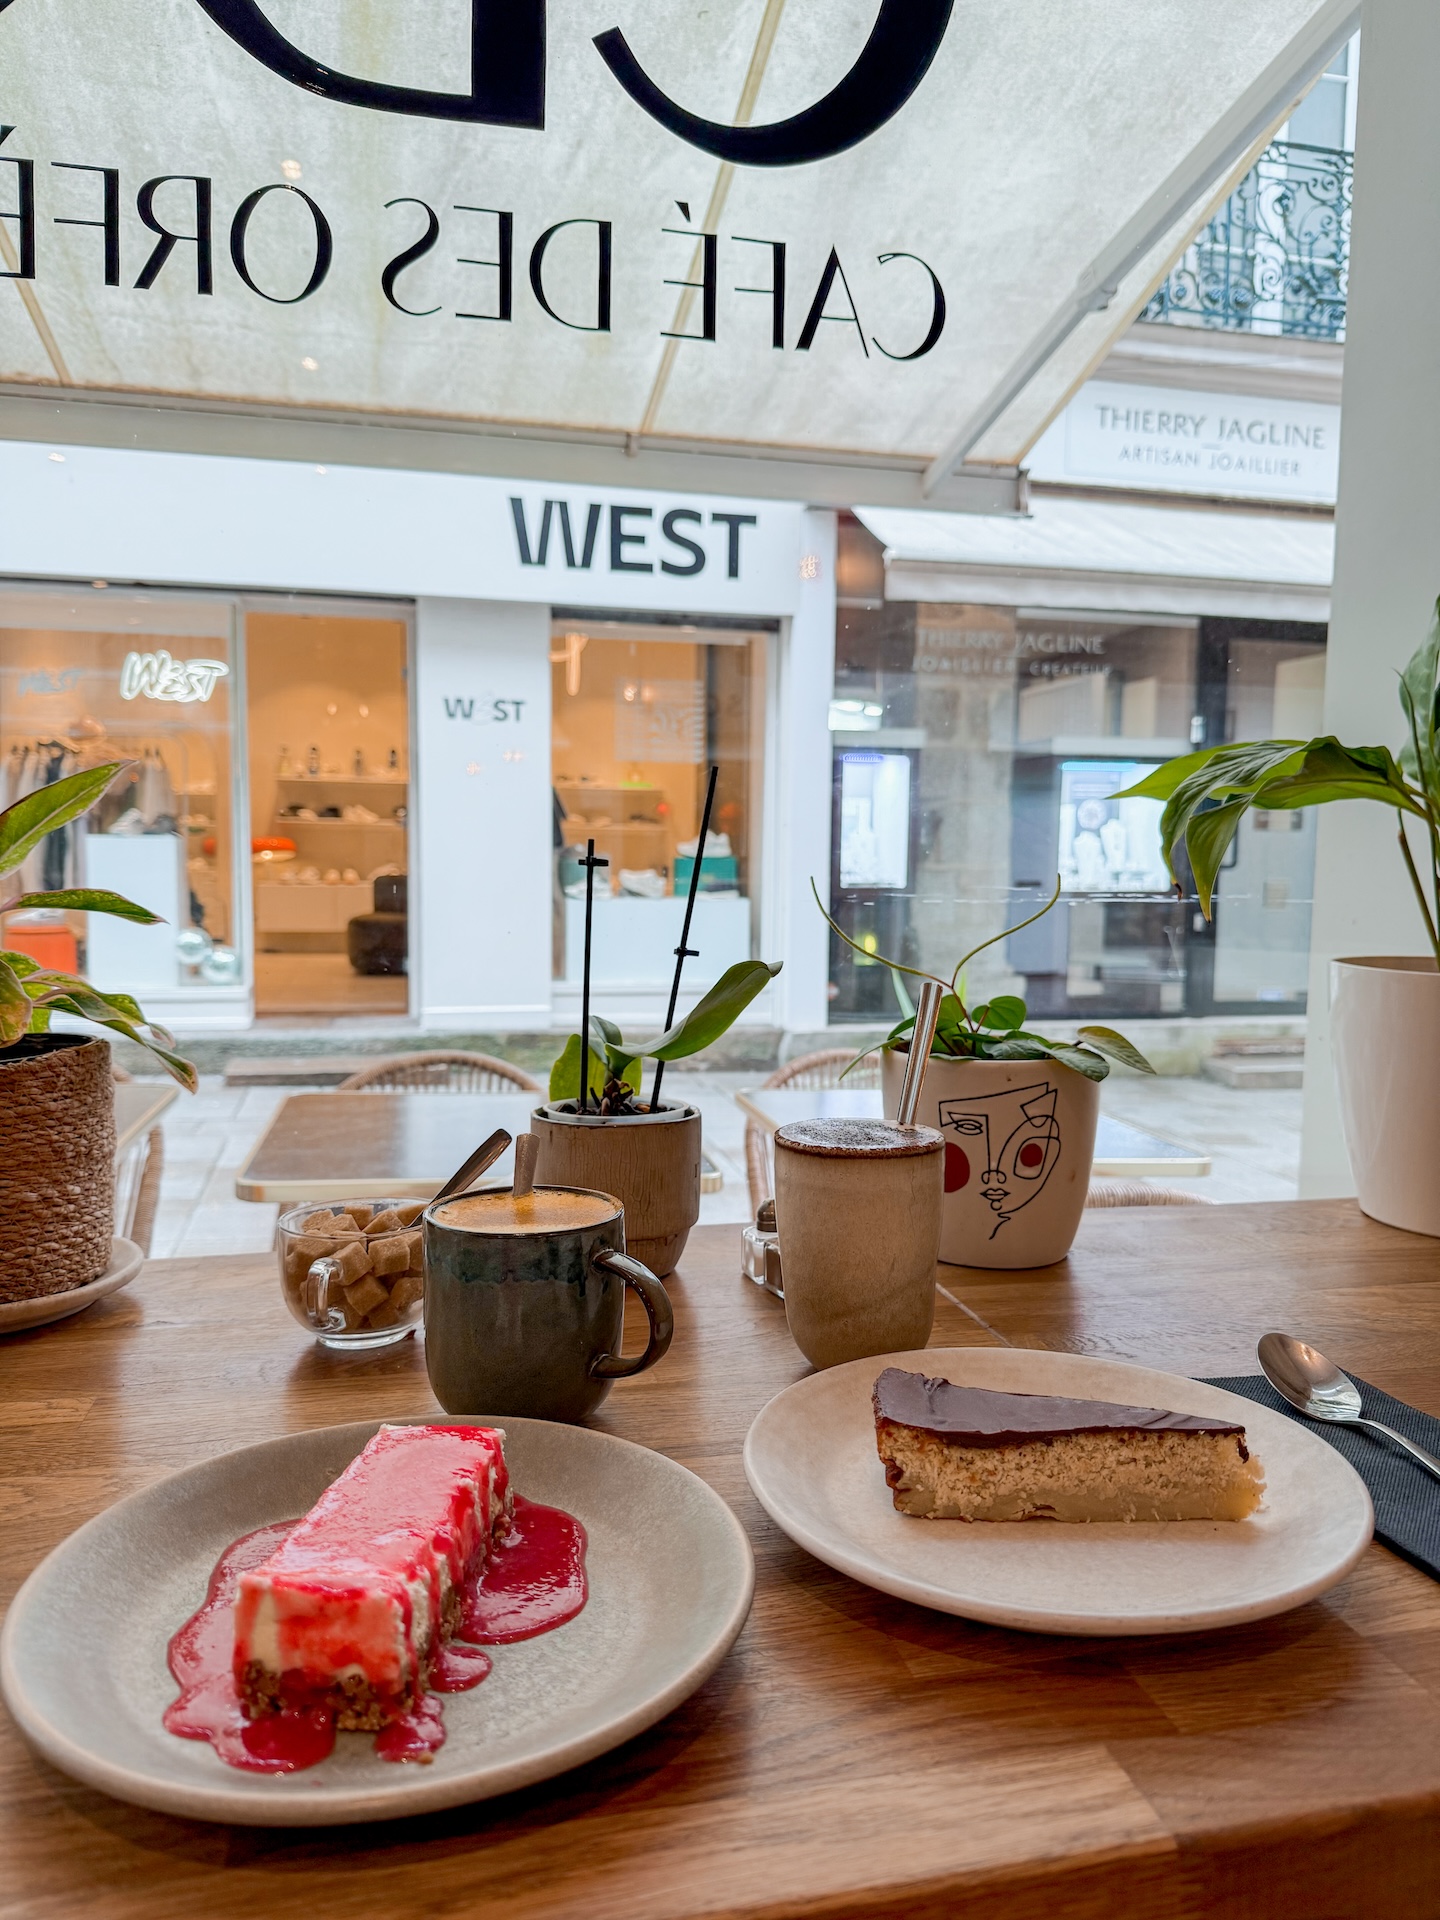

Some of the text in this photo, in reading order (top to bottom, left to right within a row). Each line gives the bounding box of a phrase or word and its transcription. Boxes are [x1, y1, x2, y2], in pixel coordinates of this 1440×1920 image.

[1096, 405, 1326, 450] THIERRY JAGLINE
[1118, 445, 1301, 476] ARTISAN JOAILLIER
[509, 497, 757, 579] WEST
